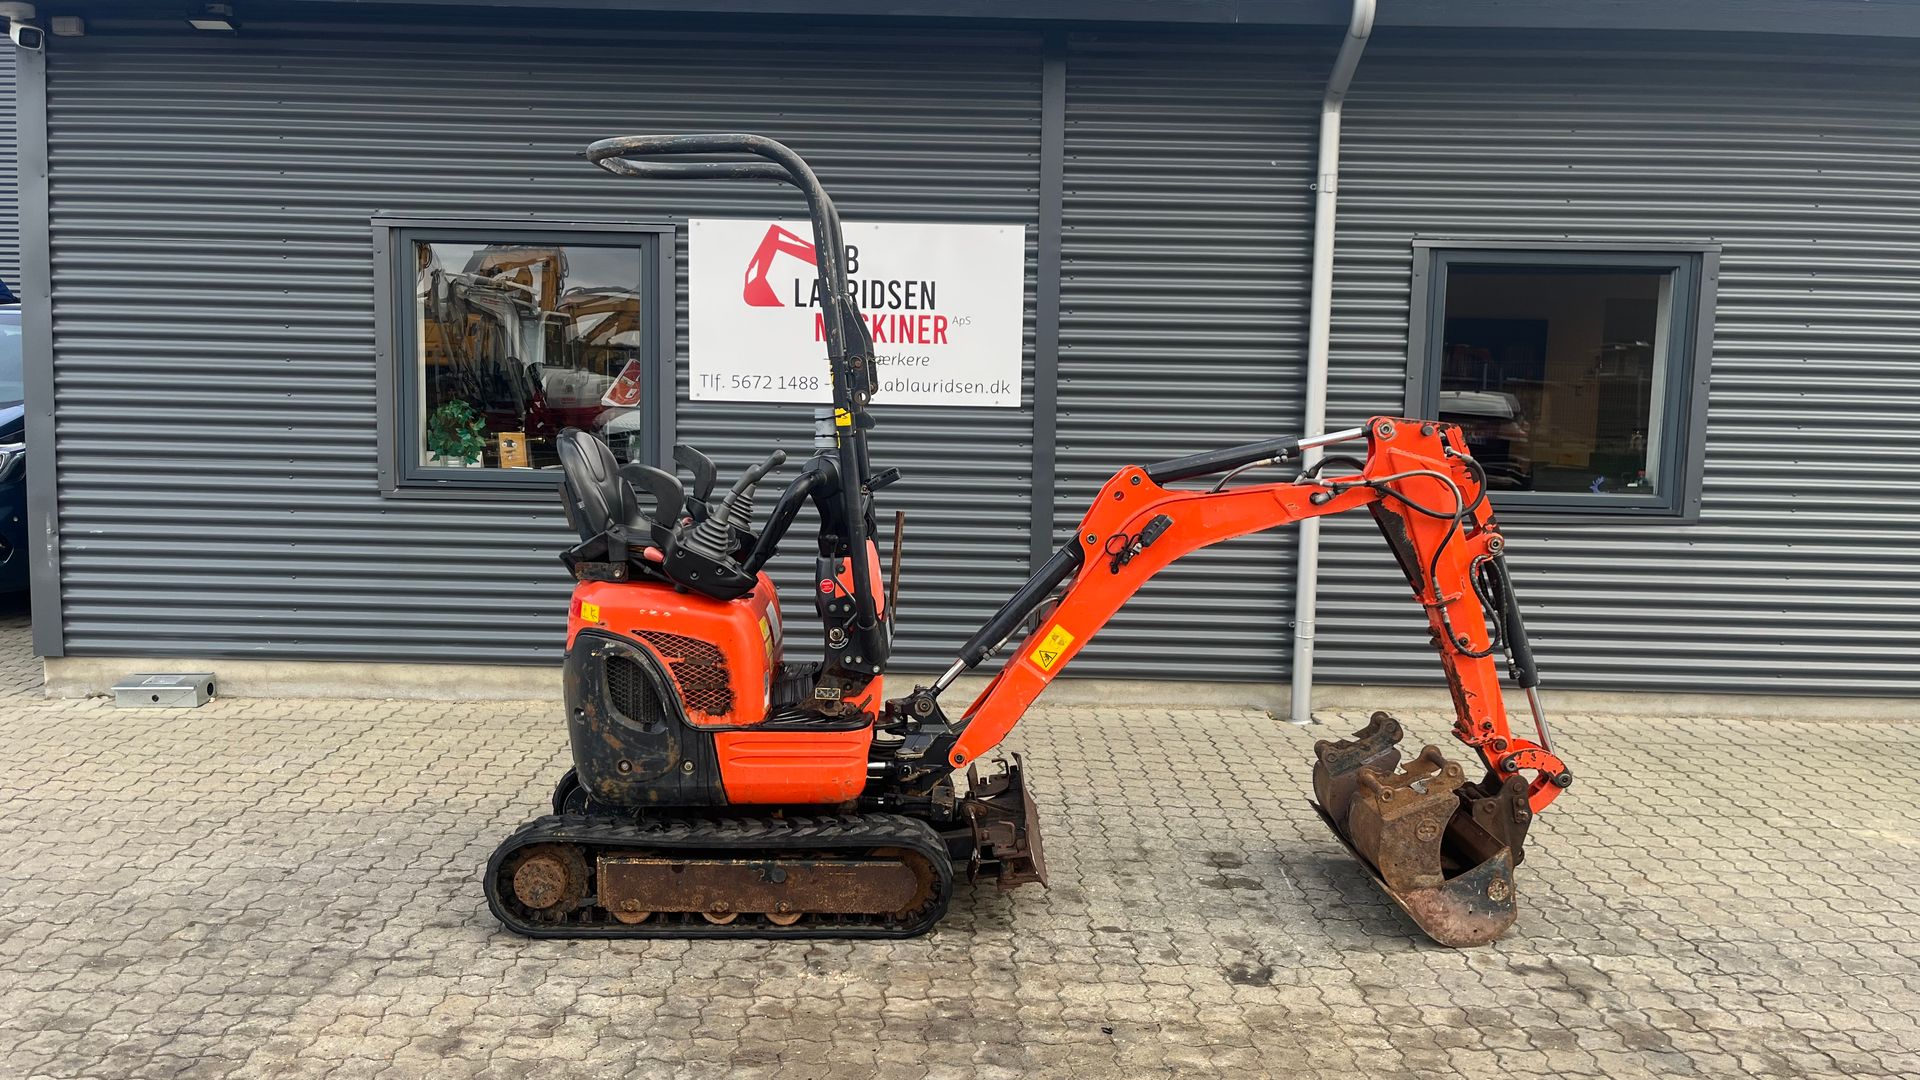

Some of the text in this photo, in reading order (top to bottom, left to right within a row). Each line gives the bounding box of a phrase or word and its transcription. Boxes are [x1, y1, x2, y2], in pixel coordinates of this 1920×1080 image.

[845, 245, 859, 274] B
[794, 277, 936, 311] LARIDSEN
[814, 312, 948, 345] MKINER
[951, 315, 972, 327] ApS
[877, 352, 930, 367] ærkere
[699, 373, 725, 391] Tlf.
[731, 374, 773, 390] 5672
[777, 375, 819, 391] 1488
[879, 377, 1011, 395] .ablauridsen.dk
